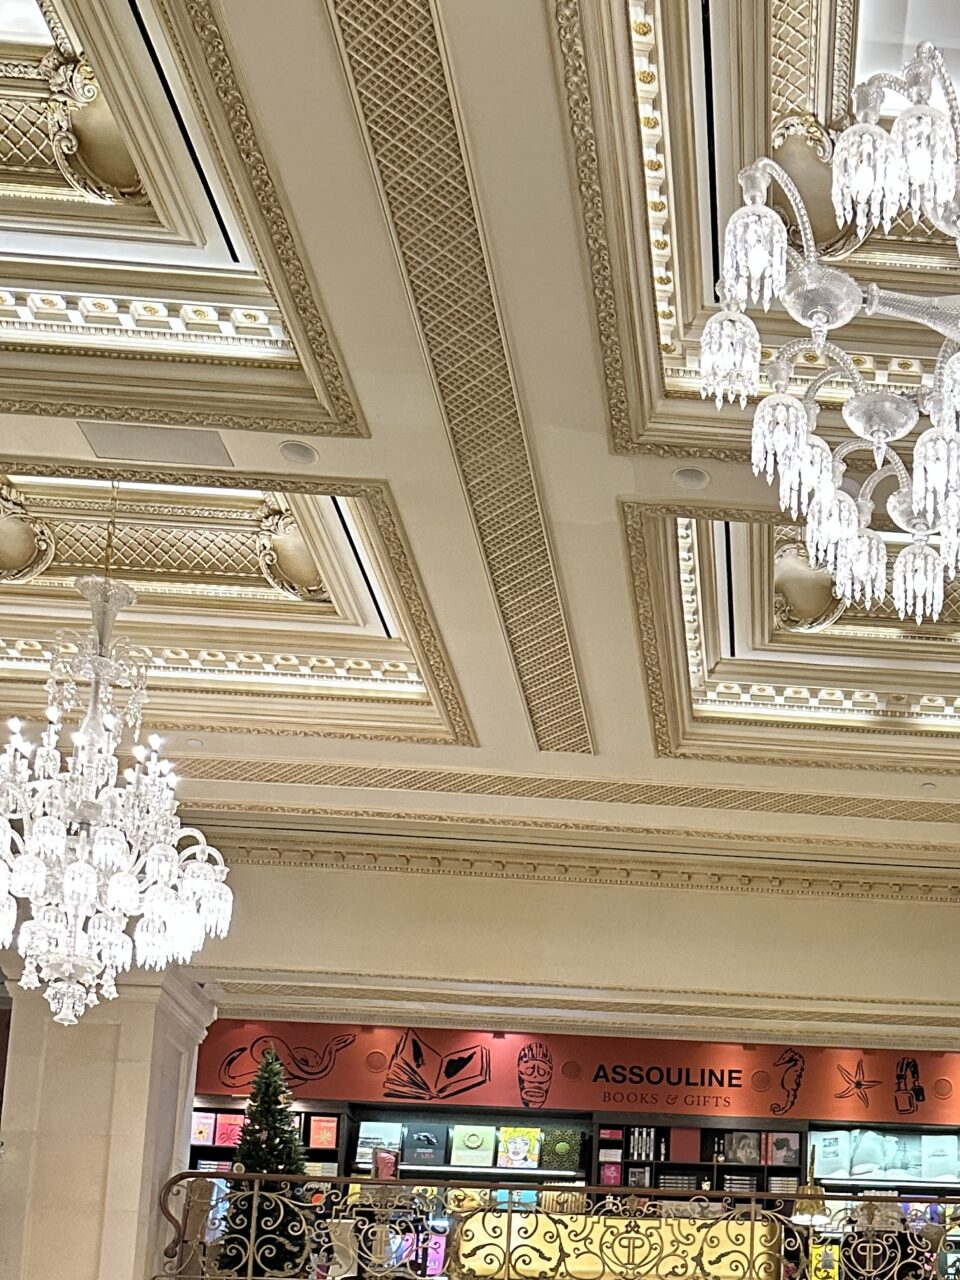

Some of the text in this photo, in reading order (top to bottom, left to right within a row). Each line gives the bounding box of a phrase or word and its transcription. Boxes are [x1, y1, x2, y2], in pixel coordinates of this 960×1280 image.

[592, 1064, 743, 1088] ASSOULINE
[602, 1091, 732, 1108] BOOKS & GIFTS
